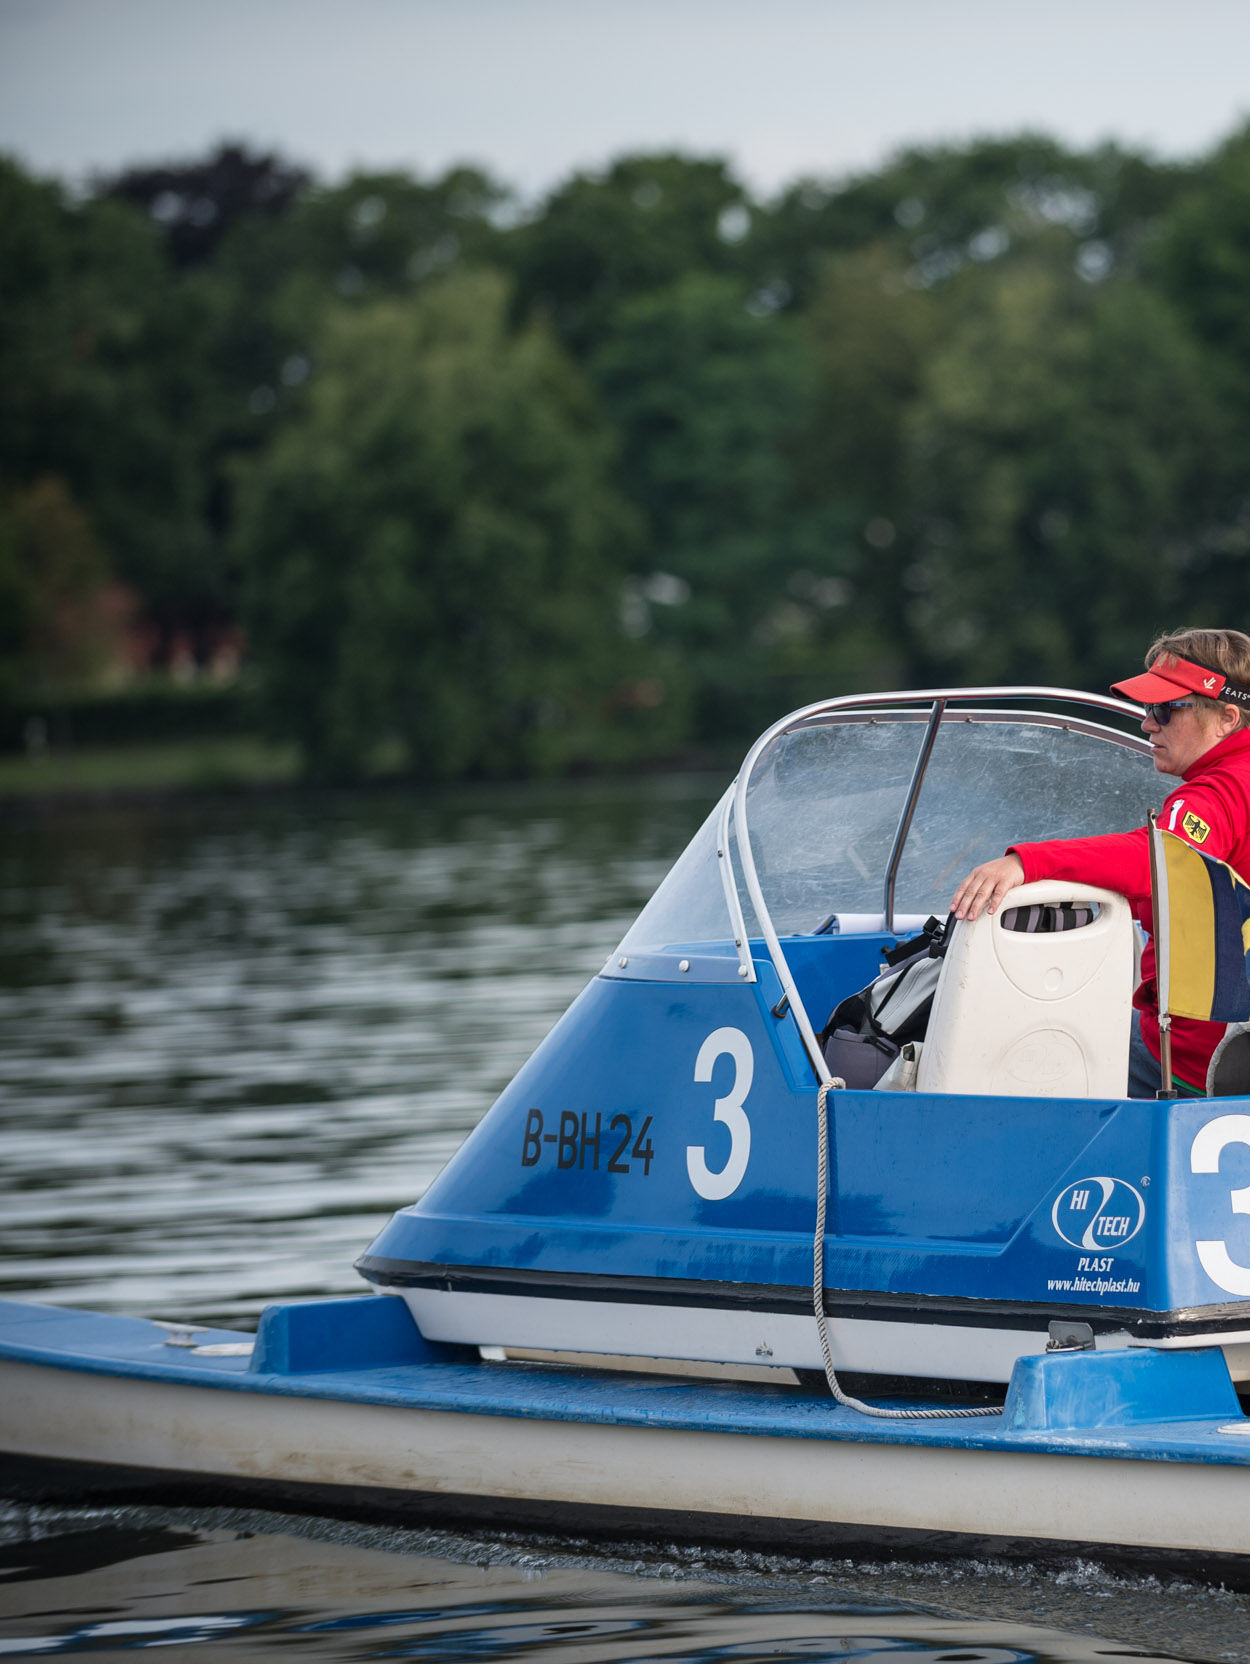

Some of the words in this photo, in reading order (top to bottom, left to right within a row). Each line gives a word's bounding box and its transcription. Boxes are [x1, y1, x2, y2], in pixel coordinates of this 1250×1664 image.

[687, 1026, 754, 1201] 3
[1069, 1190, 1090, 1210] HI
[1097, 1216, 1131, 1237] TECH
[1077, 1257, 1115, 1272] PLAST
[1047, 1277, 1141, 1296] www.hitechplast.hu
